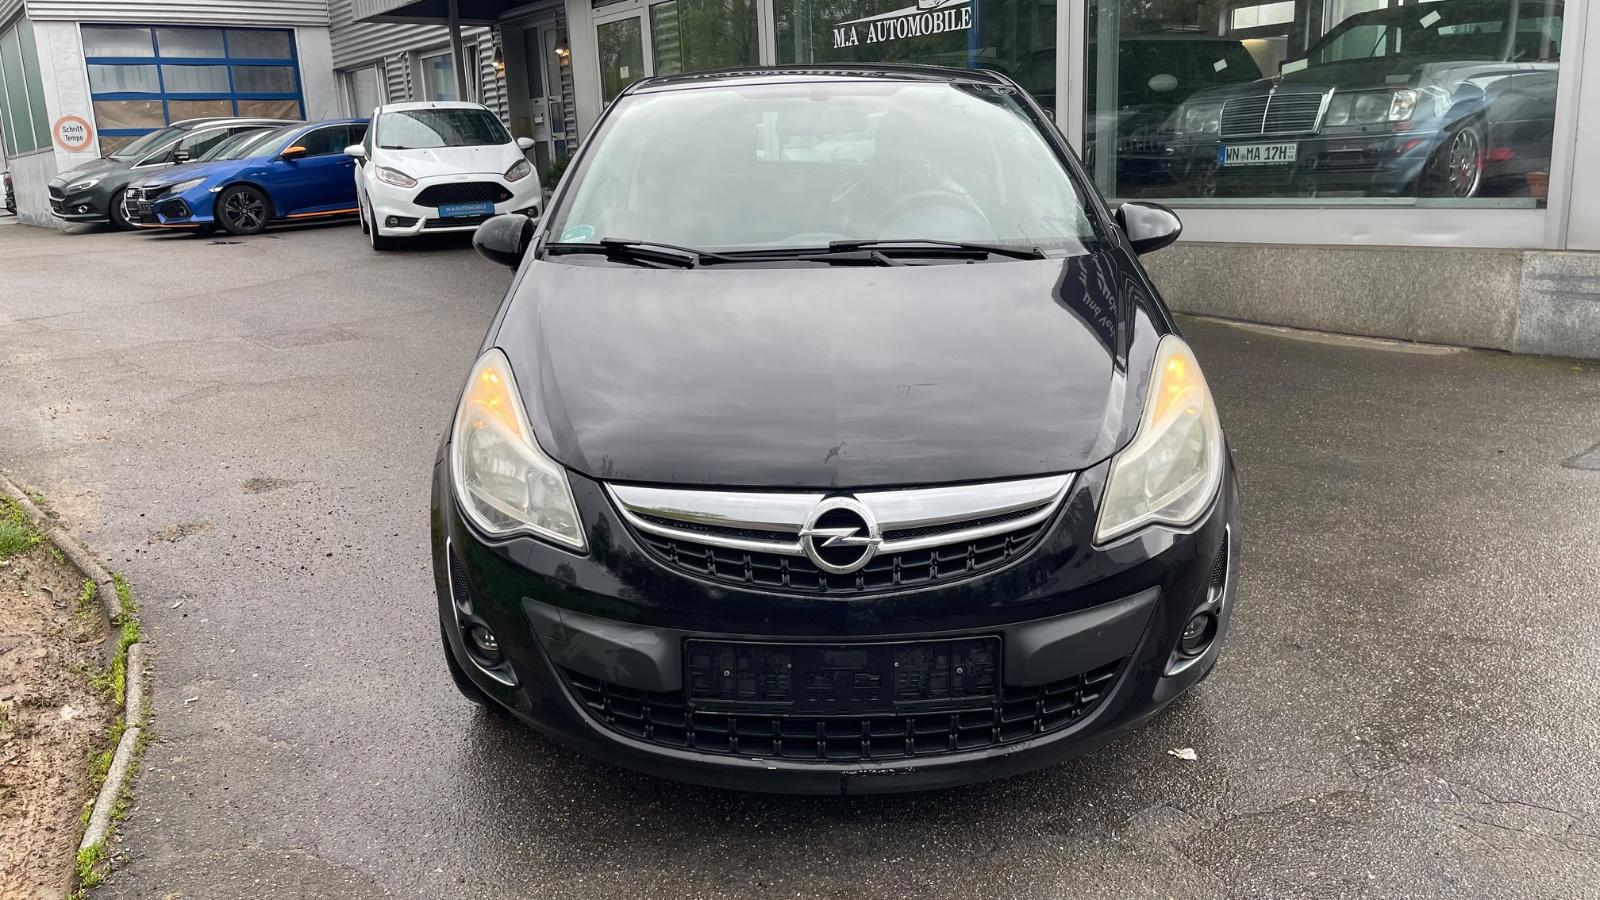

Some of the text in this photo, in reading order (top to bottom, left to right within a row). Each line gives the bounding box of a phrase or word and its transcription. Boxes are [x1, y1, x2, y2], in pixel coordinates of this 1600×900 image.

[833, 6, 972, 49] M.A AUTOMOBILE
[1226, 145, 1288, 161] WN MA 17H
